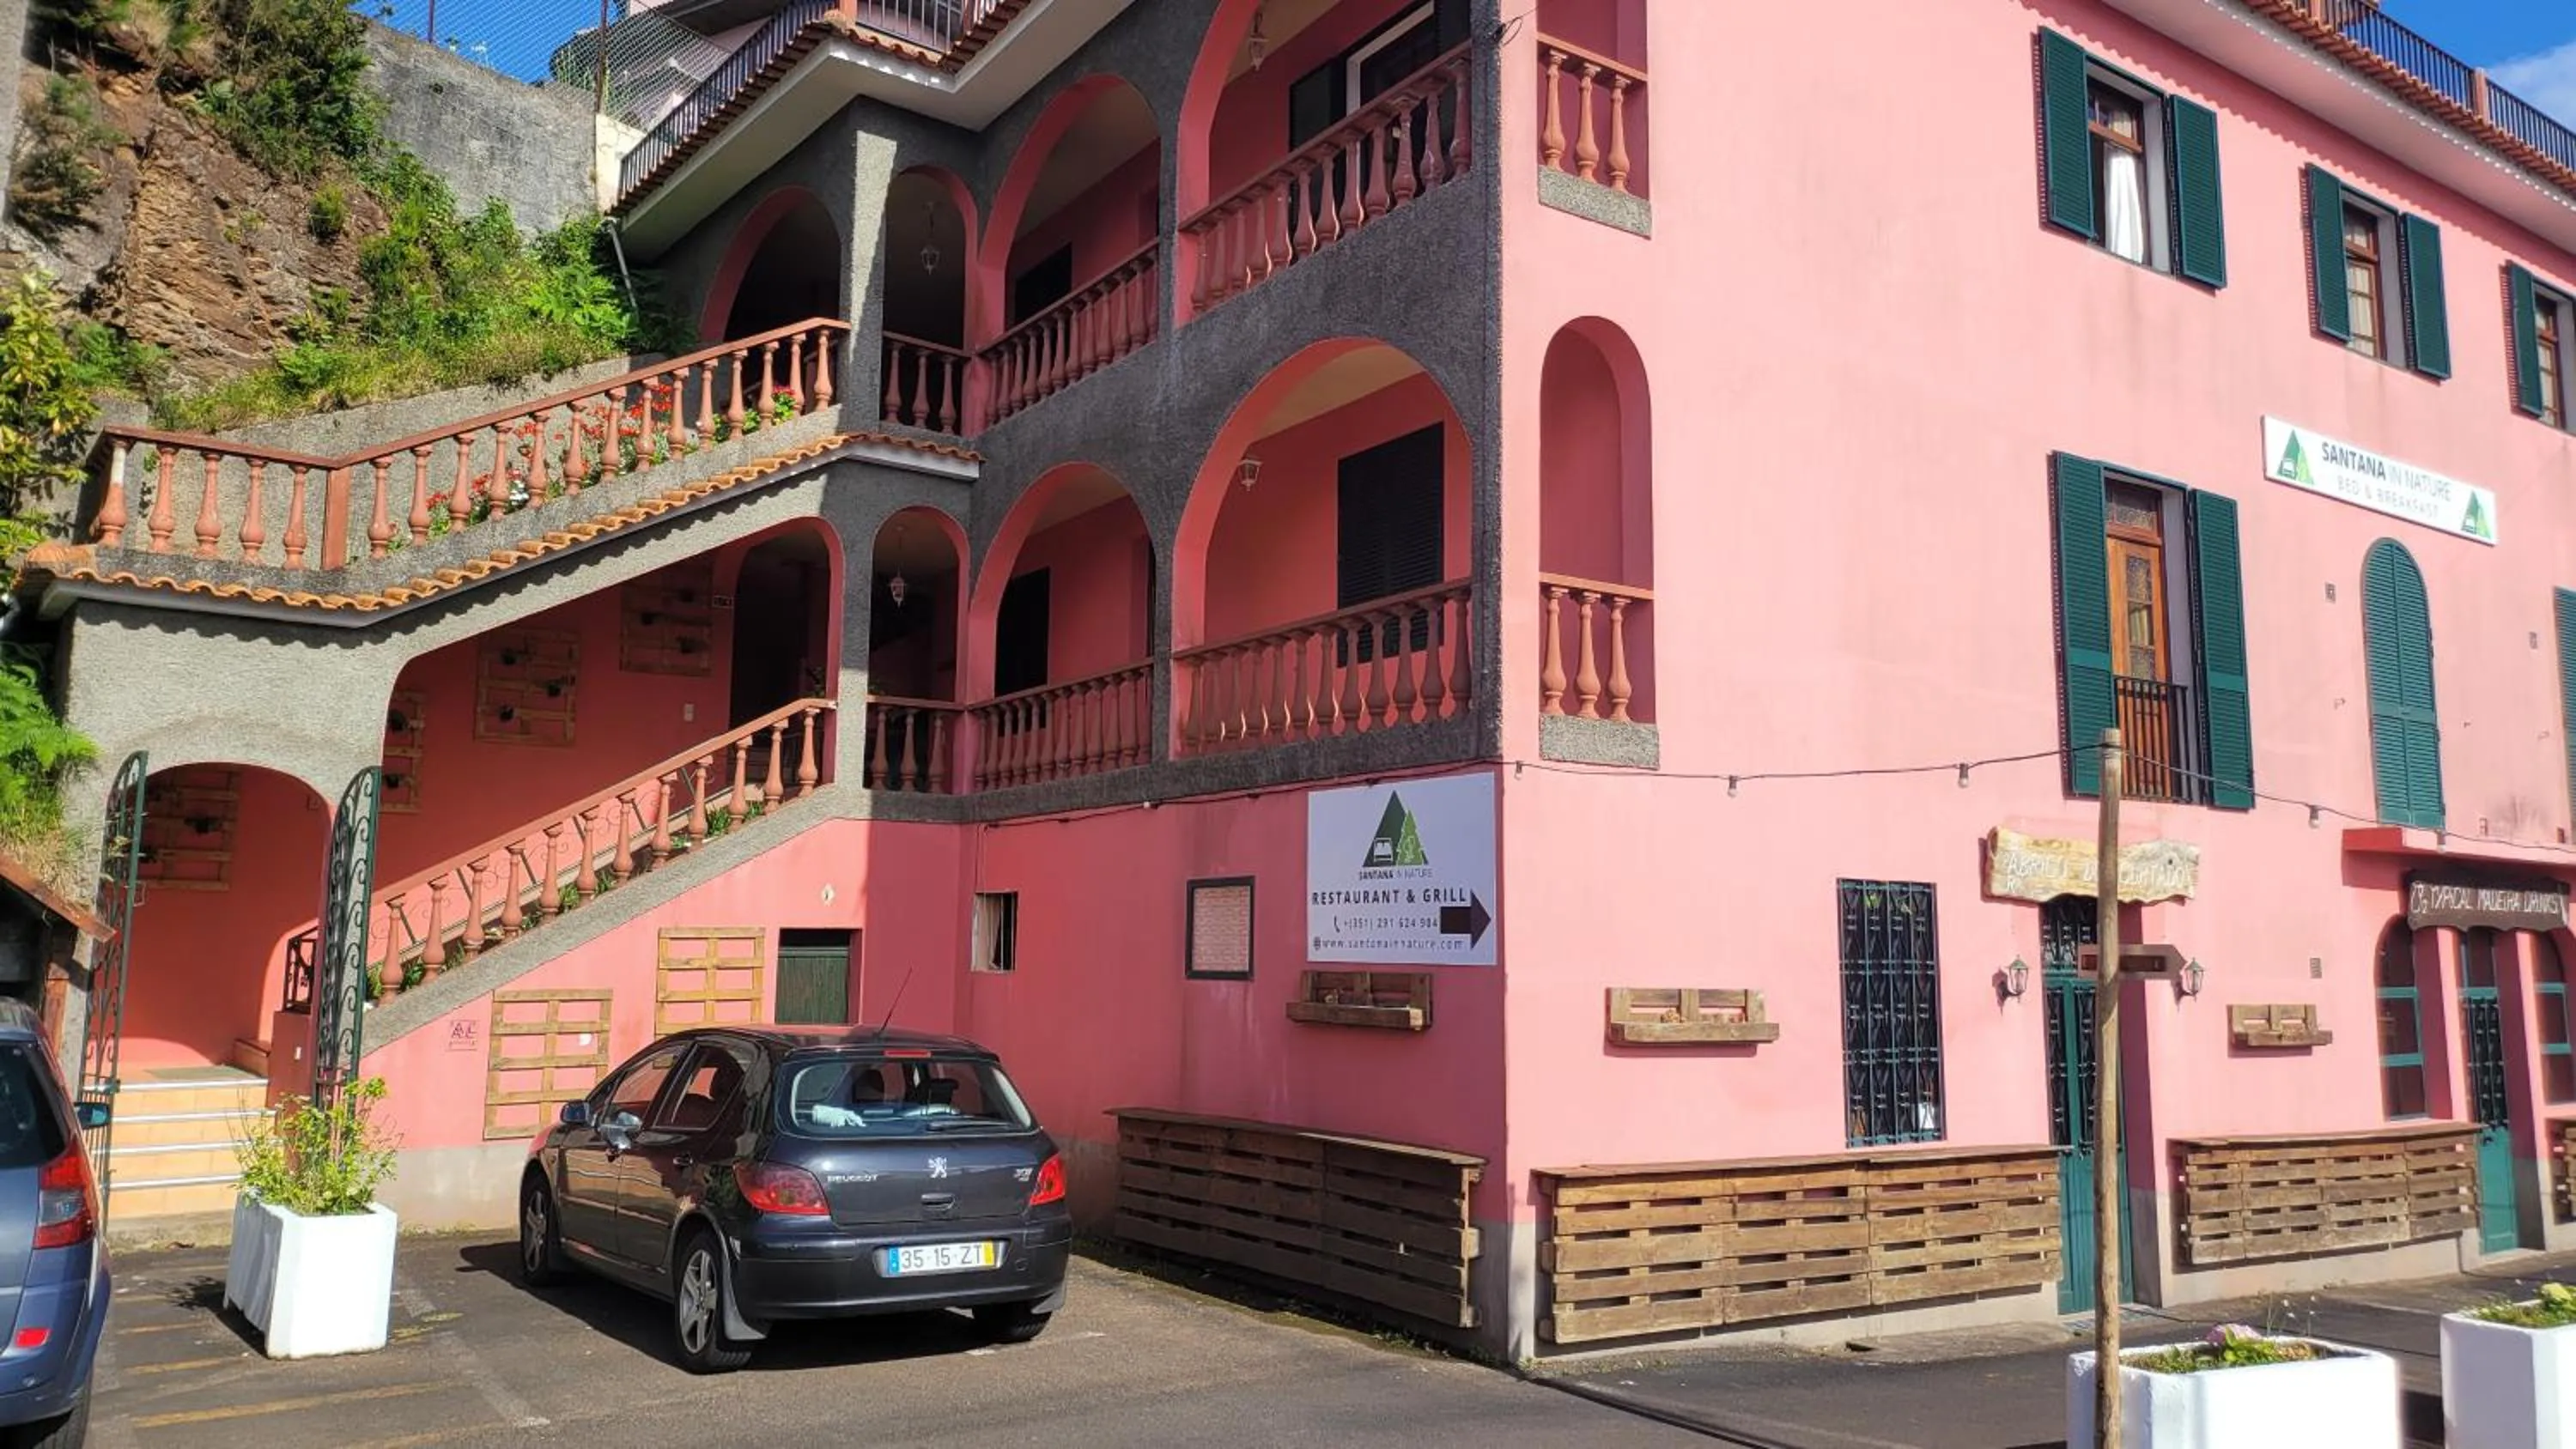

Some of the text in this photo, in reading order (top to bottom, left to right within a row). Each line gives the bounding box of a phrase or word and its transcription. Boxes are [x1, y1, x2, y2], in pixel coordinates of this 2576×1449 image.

[2321, 440, 2452, 503] SANTANA IN NATURE
[2336, 475, 2360, 496] BED
[2376, 488, 2439, 519] BREAKFAST
[1358, 869, 1394, 881] SANTANA
[1404, 867, 1434, 880] NATURE
[1312, 887, 1467, 905] RESTAURANT & GRILL
[2429, 884, 2475, 910] TYPICAL
[1376, 917, 1394, 929] 291
[452, 1022, 477, 1039] AL
[827, 1173, 878, 1184] PEUGEOT
[902, 1249, 924, 1269] 35
